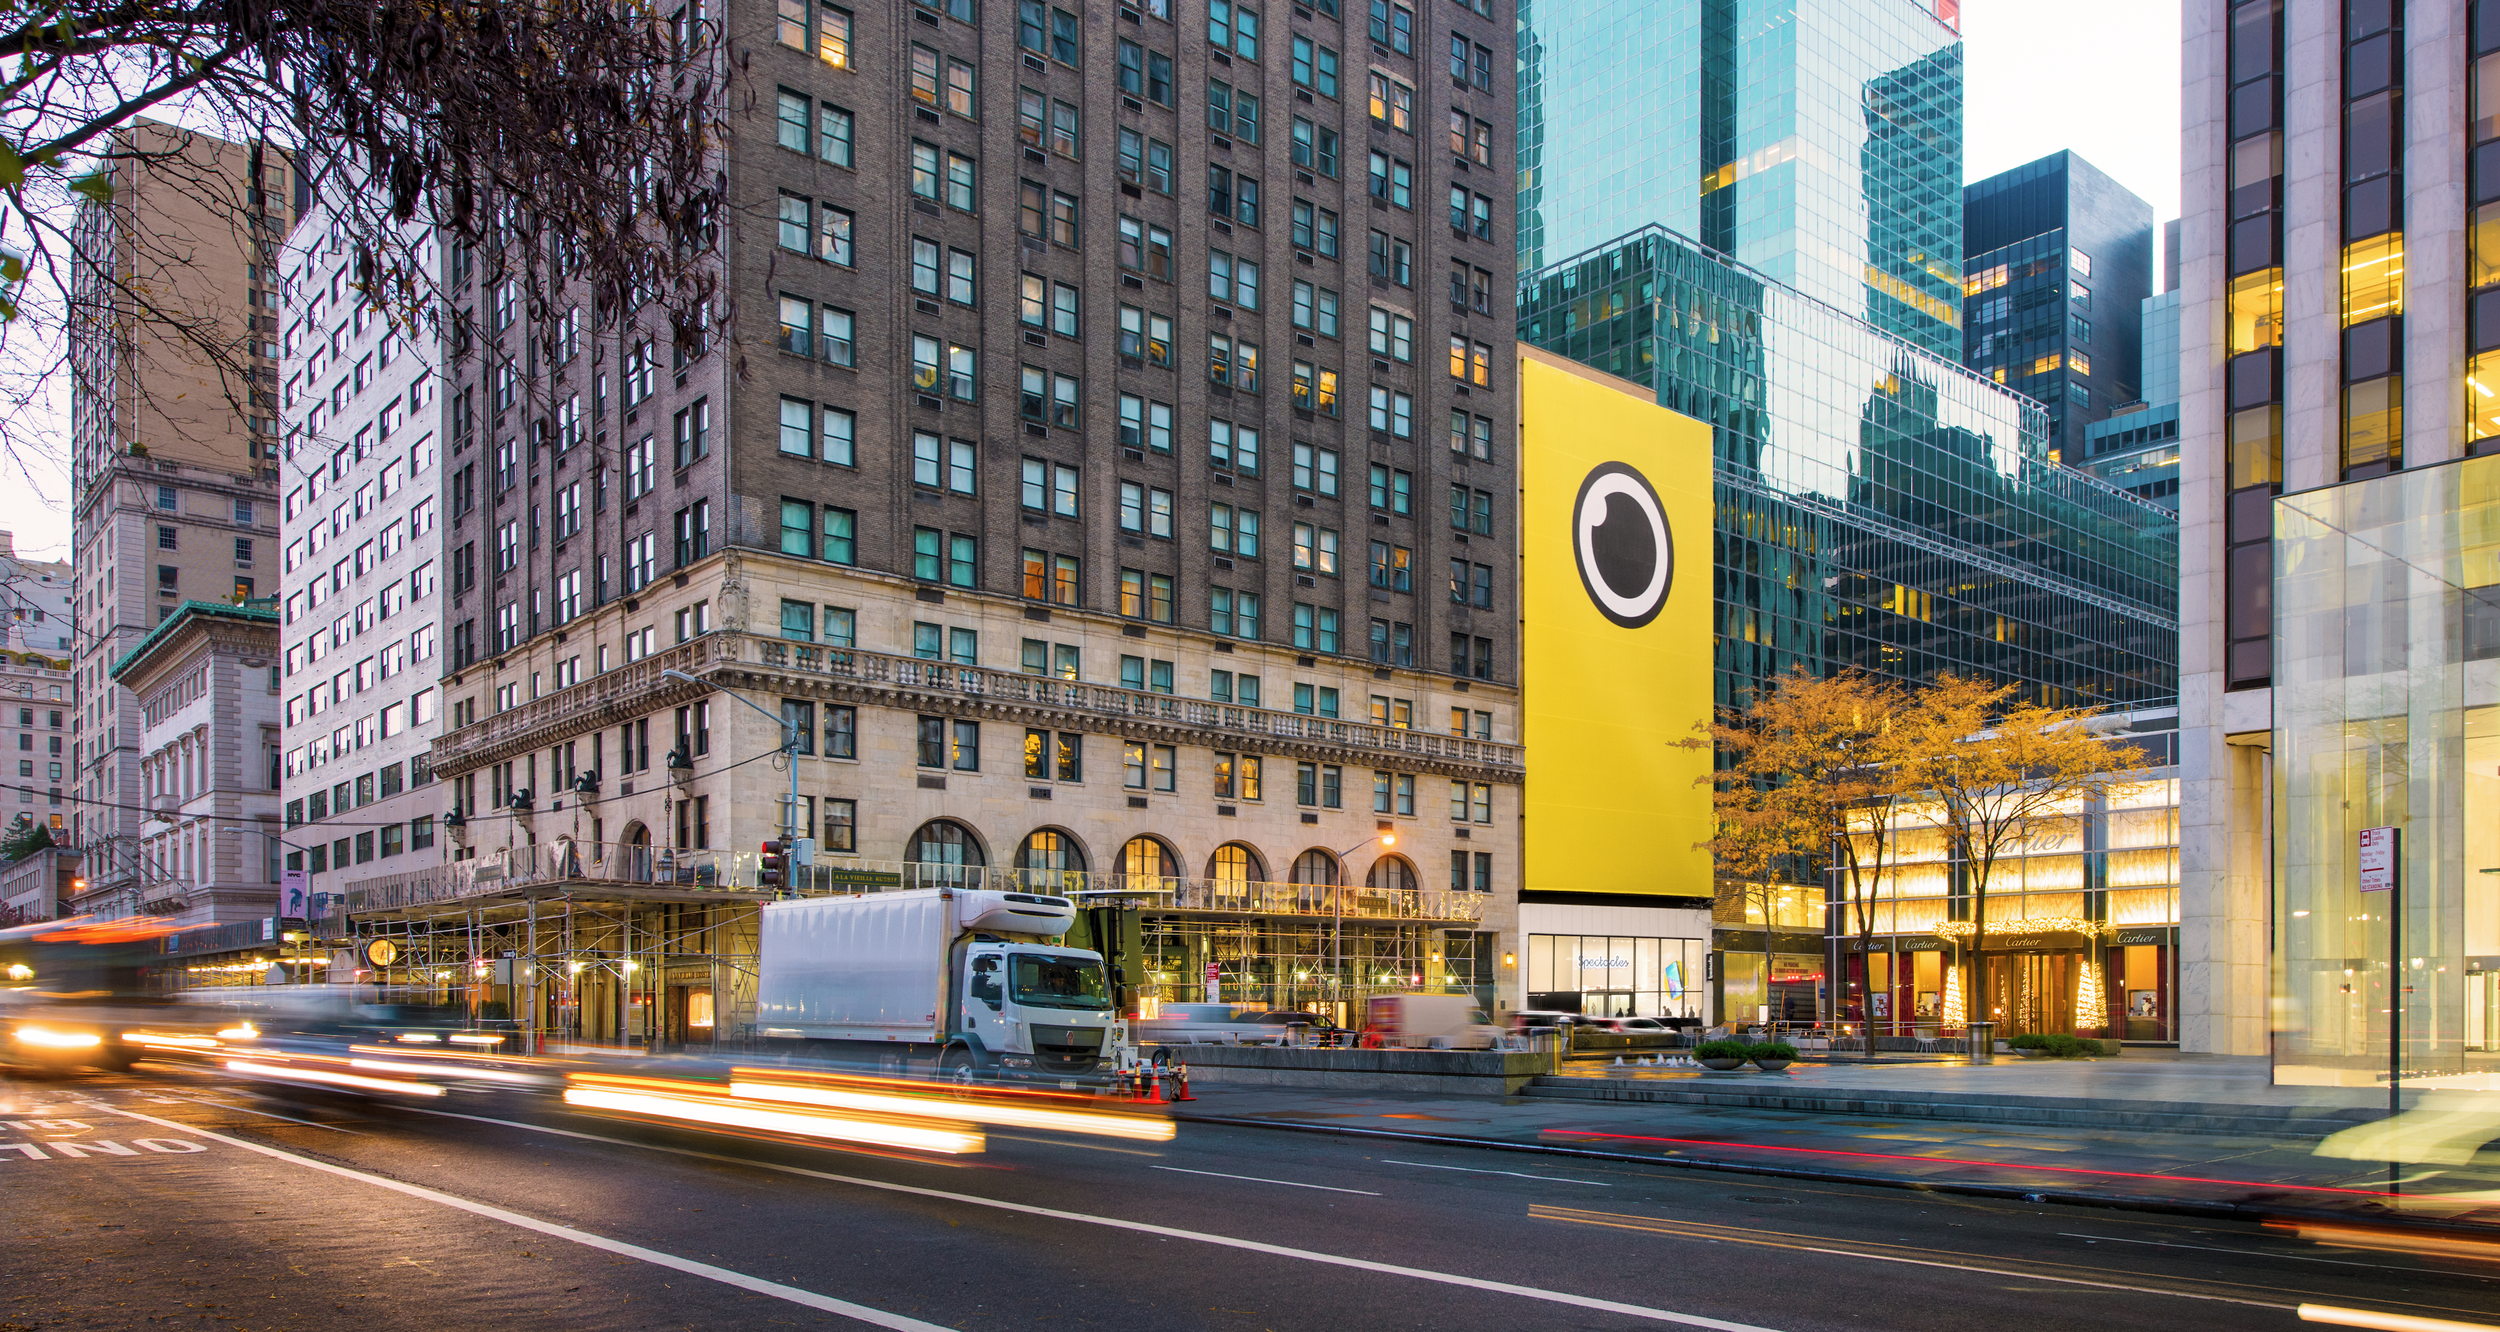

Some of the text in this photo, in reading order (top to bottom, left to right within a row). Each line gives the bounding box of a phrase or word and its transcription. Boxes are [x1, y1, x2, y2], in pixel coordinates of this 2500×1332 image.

[1905, 938, 1938, 950] Cartier
[2005, 935, 2042, 948] Cartier
[2117, 931, 2156, 944] Cartier
[1578, 956, 1629, 970] Spectacles
[0, 1139, 208, 1162] ONL
